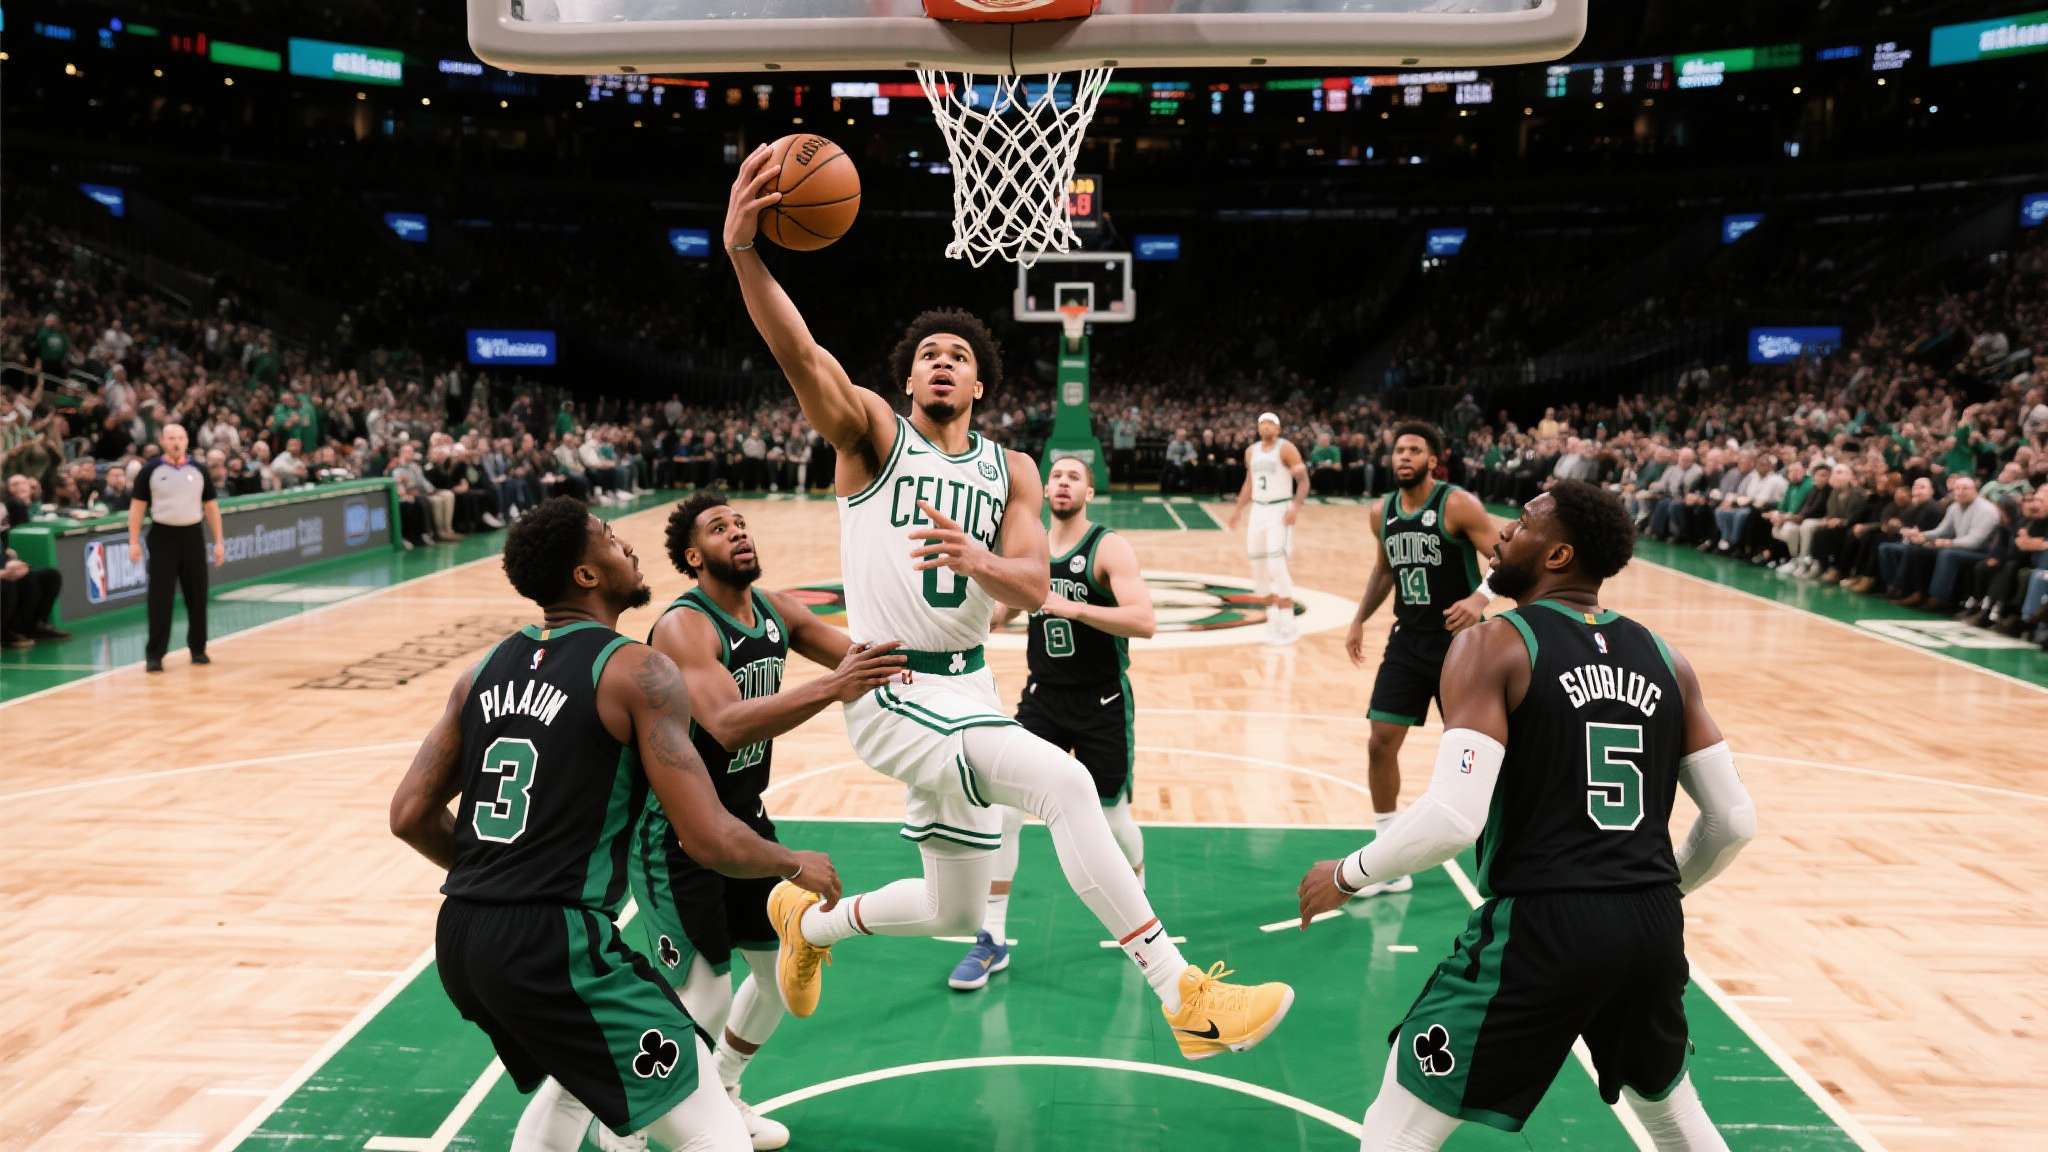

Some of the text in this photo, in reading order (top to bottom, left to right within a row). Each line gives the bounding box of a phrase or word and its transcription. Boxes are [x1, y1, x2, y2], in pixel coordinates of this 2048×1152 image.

[890, 475, 1004, 552] CELTICS
[1400, 567, 1431, 605] 14
[480, 680, 568, 726] PIAAUN
[472, 737, 539, 844] 3
[1586, 721, 1645, 831] 5
